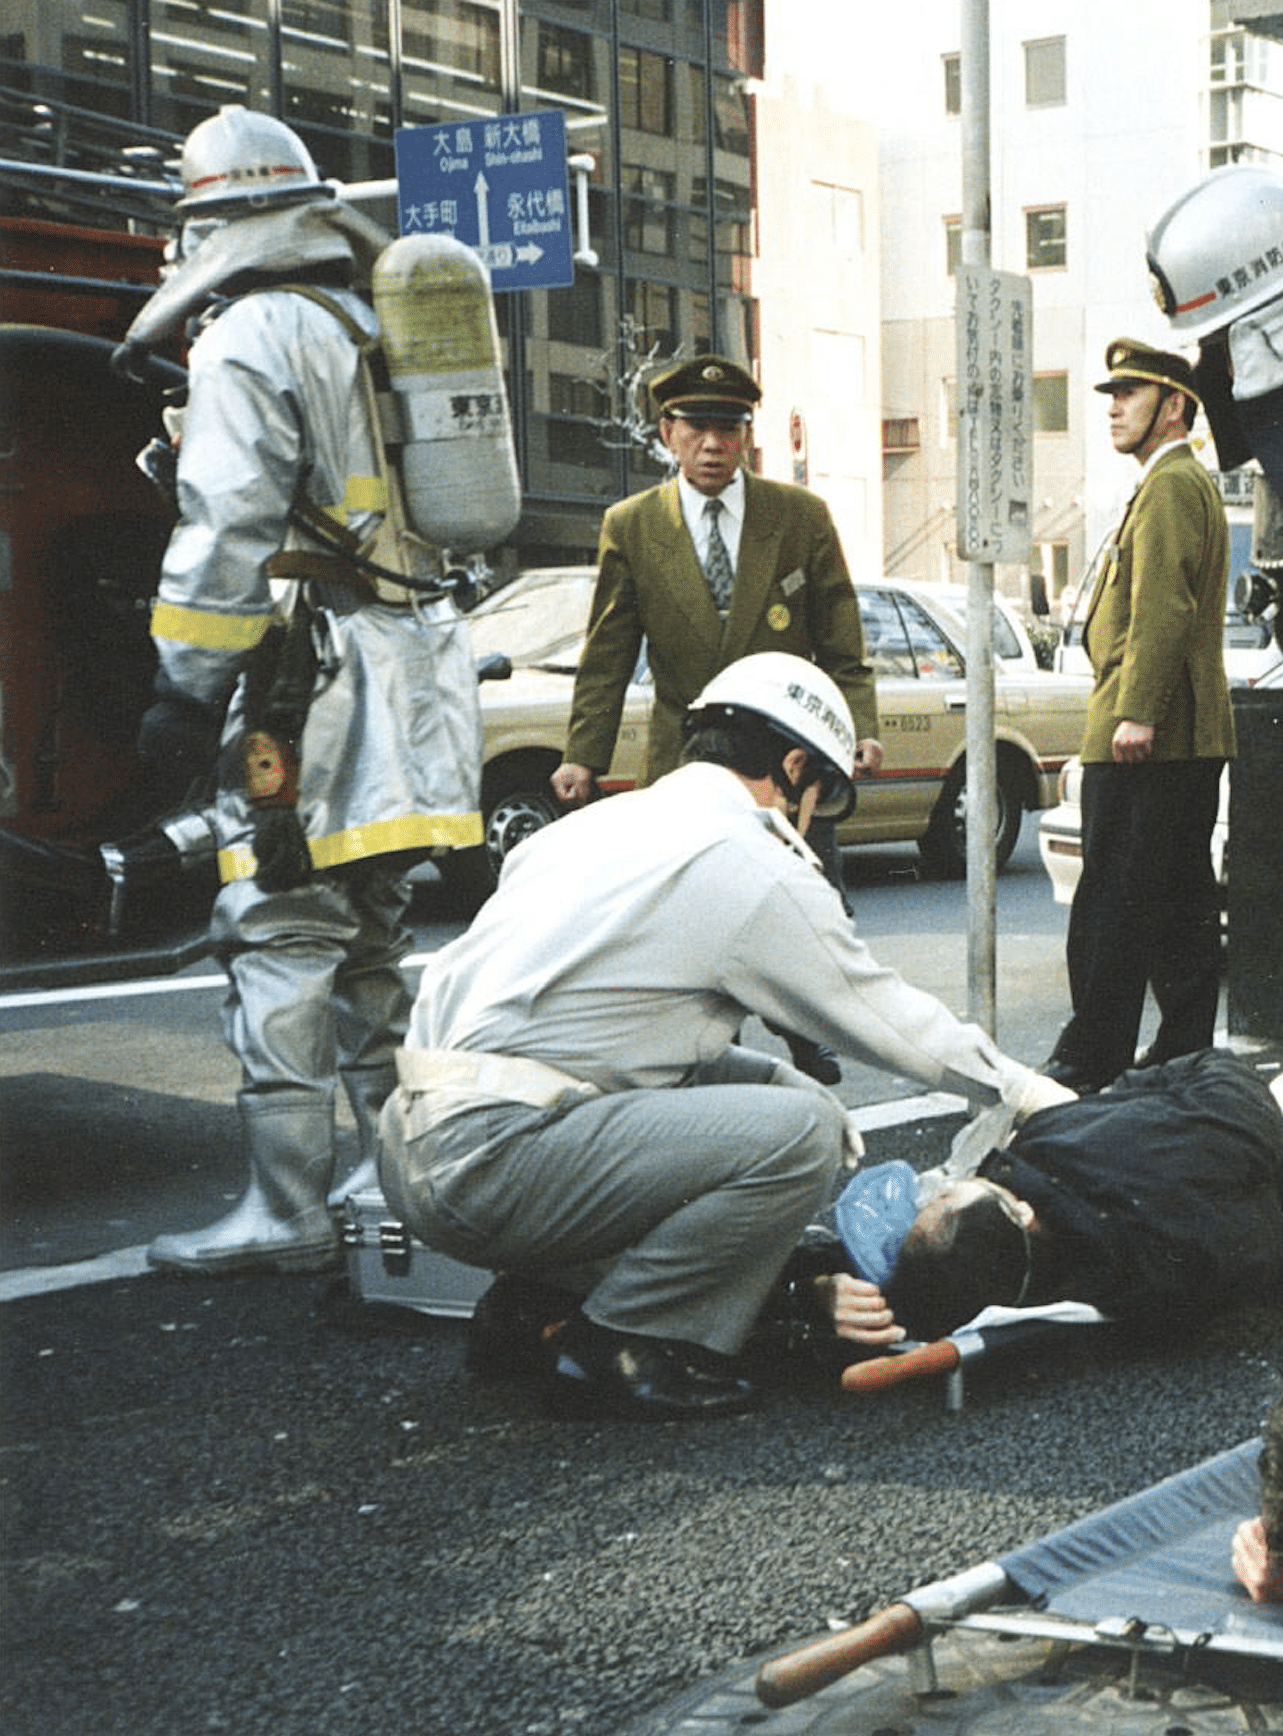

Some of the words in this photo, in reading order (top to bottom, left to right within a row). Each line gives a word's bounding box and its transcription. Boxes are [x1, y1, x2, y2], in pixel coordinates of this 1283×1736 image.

[432, 127, 473, 156] 大島
[484, 119, 541, 149] 新大橋
[405, 199, 458, 229] 大手町
[507, 187, 565, 220] 永代橋
